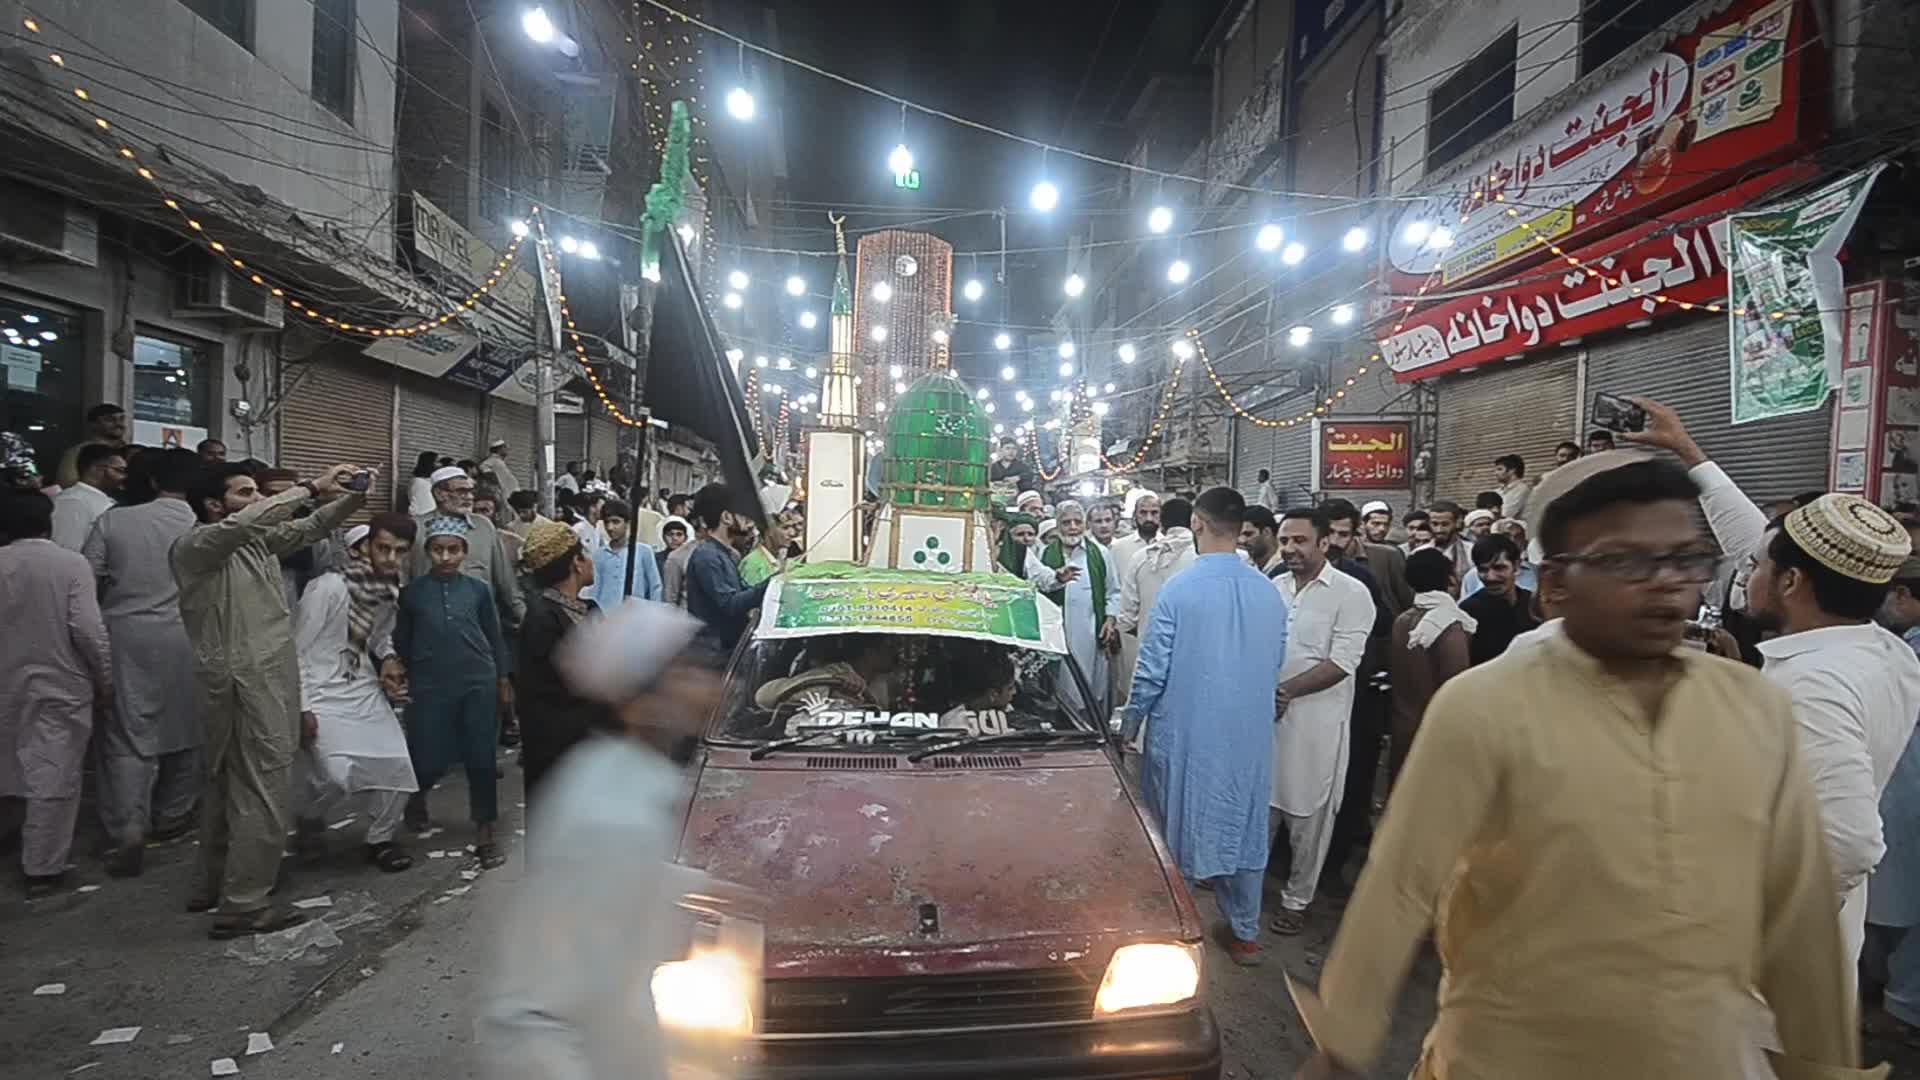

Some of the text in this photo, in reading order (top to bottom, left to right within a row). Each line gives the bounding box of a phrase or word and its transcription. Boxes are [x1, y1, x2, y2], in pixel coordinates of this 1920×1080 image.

[1549, 59, 1670, 169] الجنت
[1555, 230, 1712, 320] الجنت
[1327, 431, 1404, 460] الجنت
